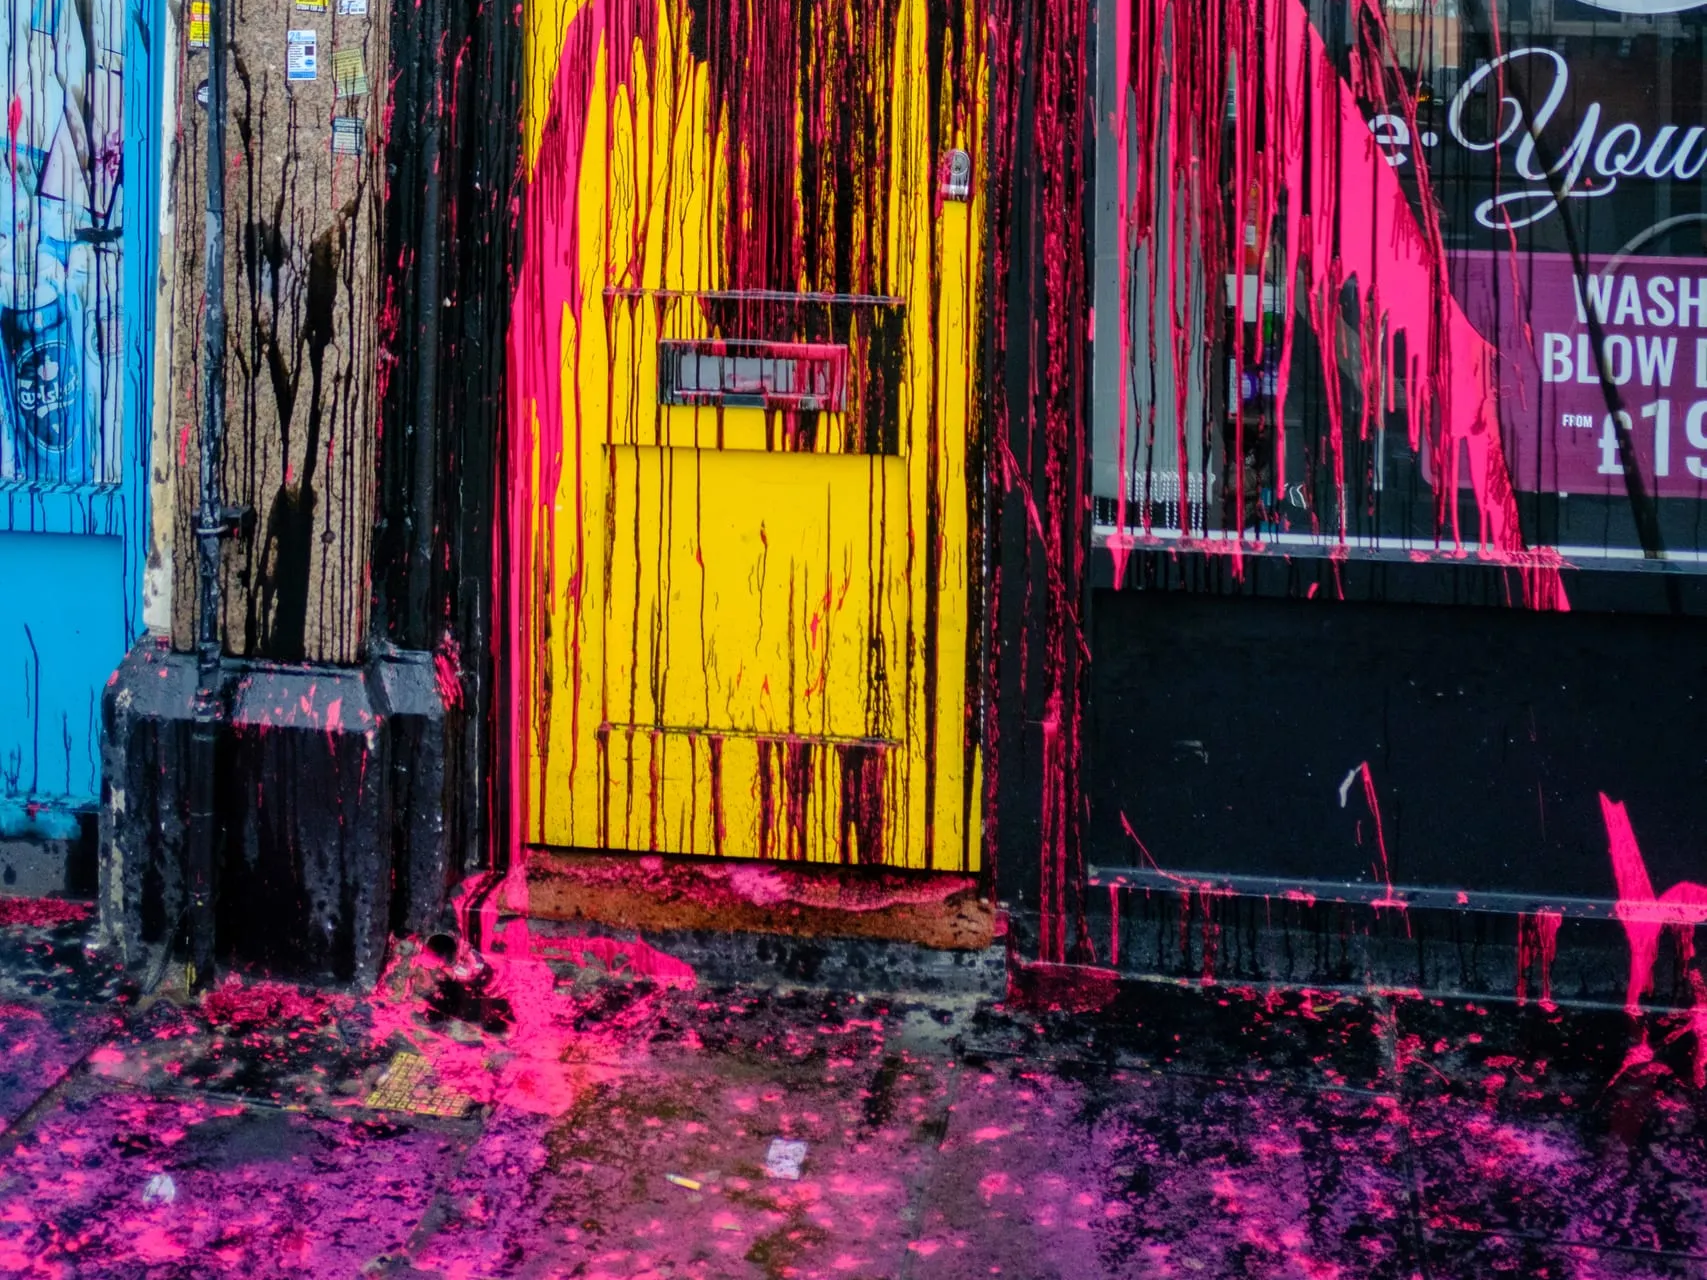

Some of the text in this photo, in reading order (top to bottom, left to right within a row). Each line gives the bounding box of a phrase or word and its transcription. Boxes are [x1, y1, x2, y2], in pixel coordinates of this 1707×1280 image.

[1572, 274, 1707, 327] WASH
[1542, 332, 1679, 388] BLOW
[1562, 413, 1593, 429] FROM
